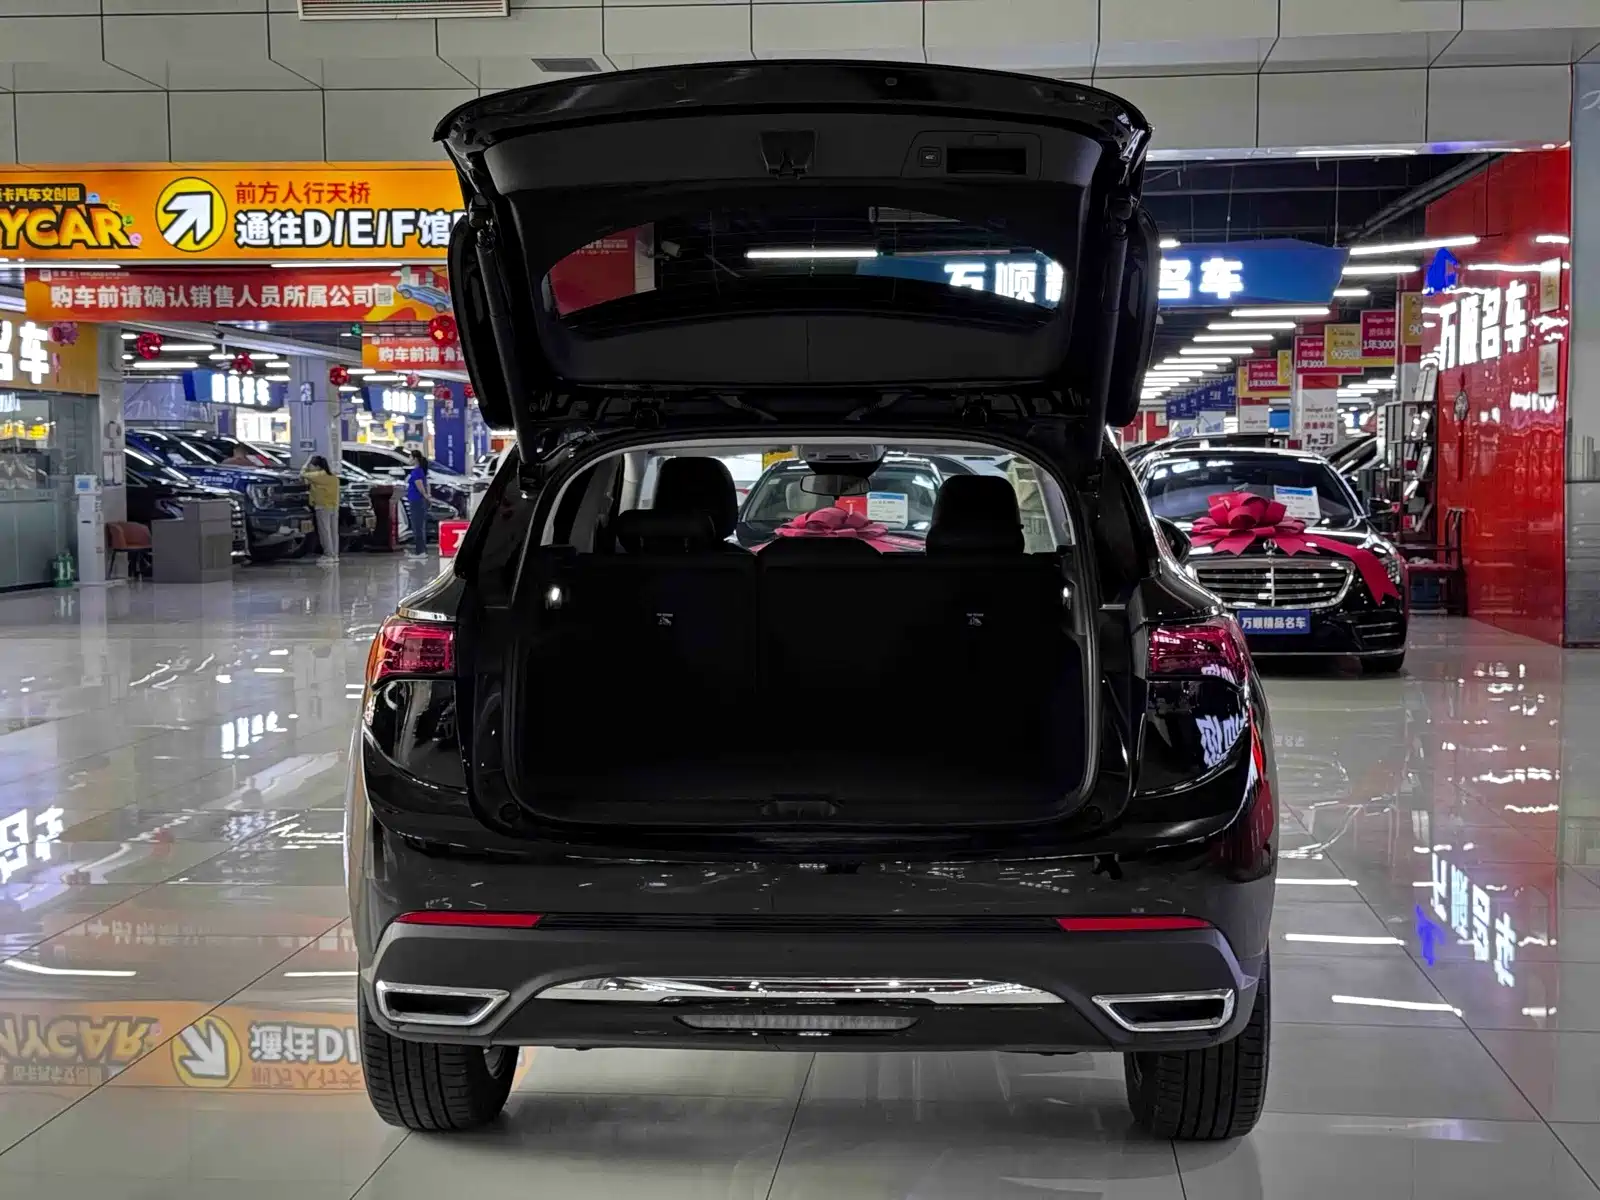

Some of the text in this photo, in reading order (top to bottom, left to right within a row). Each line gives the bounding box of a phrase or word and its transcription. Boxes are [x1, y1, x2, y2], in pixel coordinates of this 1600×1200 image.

[0, 187, 80, 202] 卡汽车文创园
[235, 181, 371, 204] 前方人行天桥
[236, 210, 466, 247] 通往D/E/F馆
